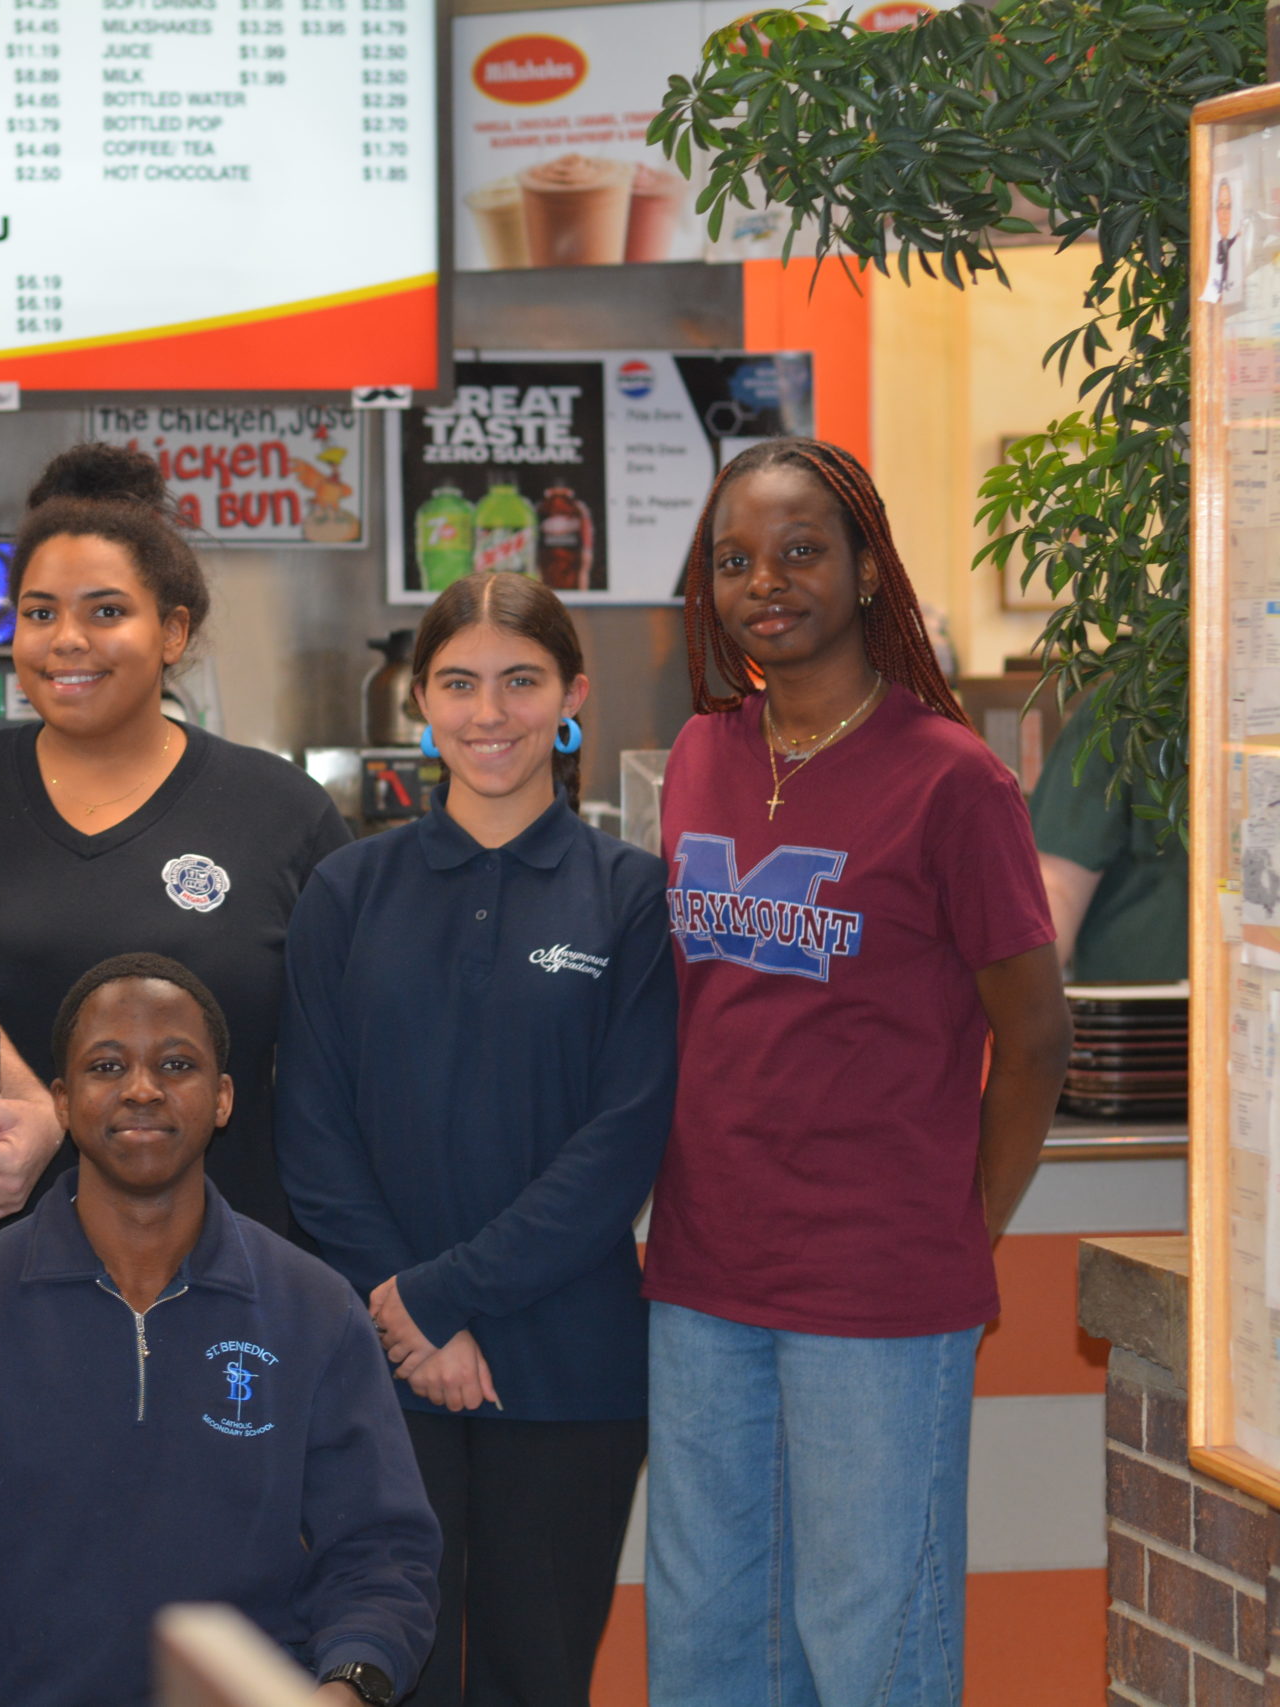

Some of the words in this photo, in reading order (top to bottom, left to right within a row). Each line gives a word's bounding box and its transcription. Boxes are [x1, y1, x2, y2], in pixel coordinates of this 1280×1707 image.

[101, 18, 213, 35] MILKSHAKES
[101, 42, 153, 60] JUICE
[102, 68, 144, 84] MILK
[102, 91, 183, 107] BOTTLED
[187, 91, 246, 108] WATER
[103, 115, 183, 132] BOTTLED
[186, 116, 224, 132] POP
[103, 140, 177, 157] COFFEE/
[182, 140, 216, 157] TEA
[103, 164, 140, 181] HOT
[144, 164, 251, 182] CHOCOLATE
[16, 274, 62, 291] $6.19
[16, 295, 63, 312] $6.19
[16, 317, 63, 334] $6.19
[426, 386, 582, 416] REAT
[423, 417, 582, 446] TASTE.
[423, 446, 489, 463] ZERO
[528, 944, 610, 967] Marymount
[540, 958, 603, 979] Academy
[220, 1340, 279, 1366] BENEDICT
[244, 1422, 276, 1437] SCHOOL
